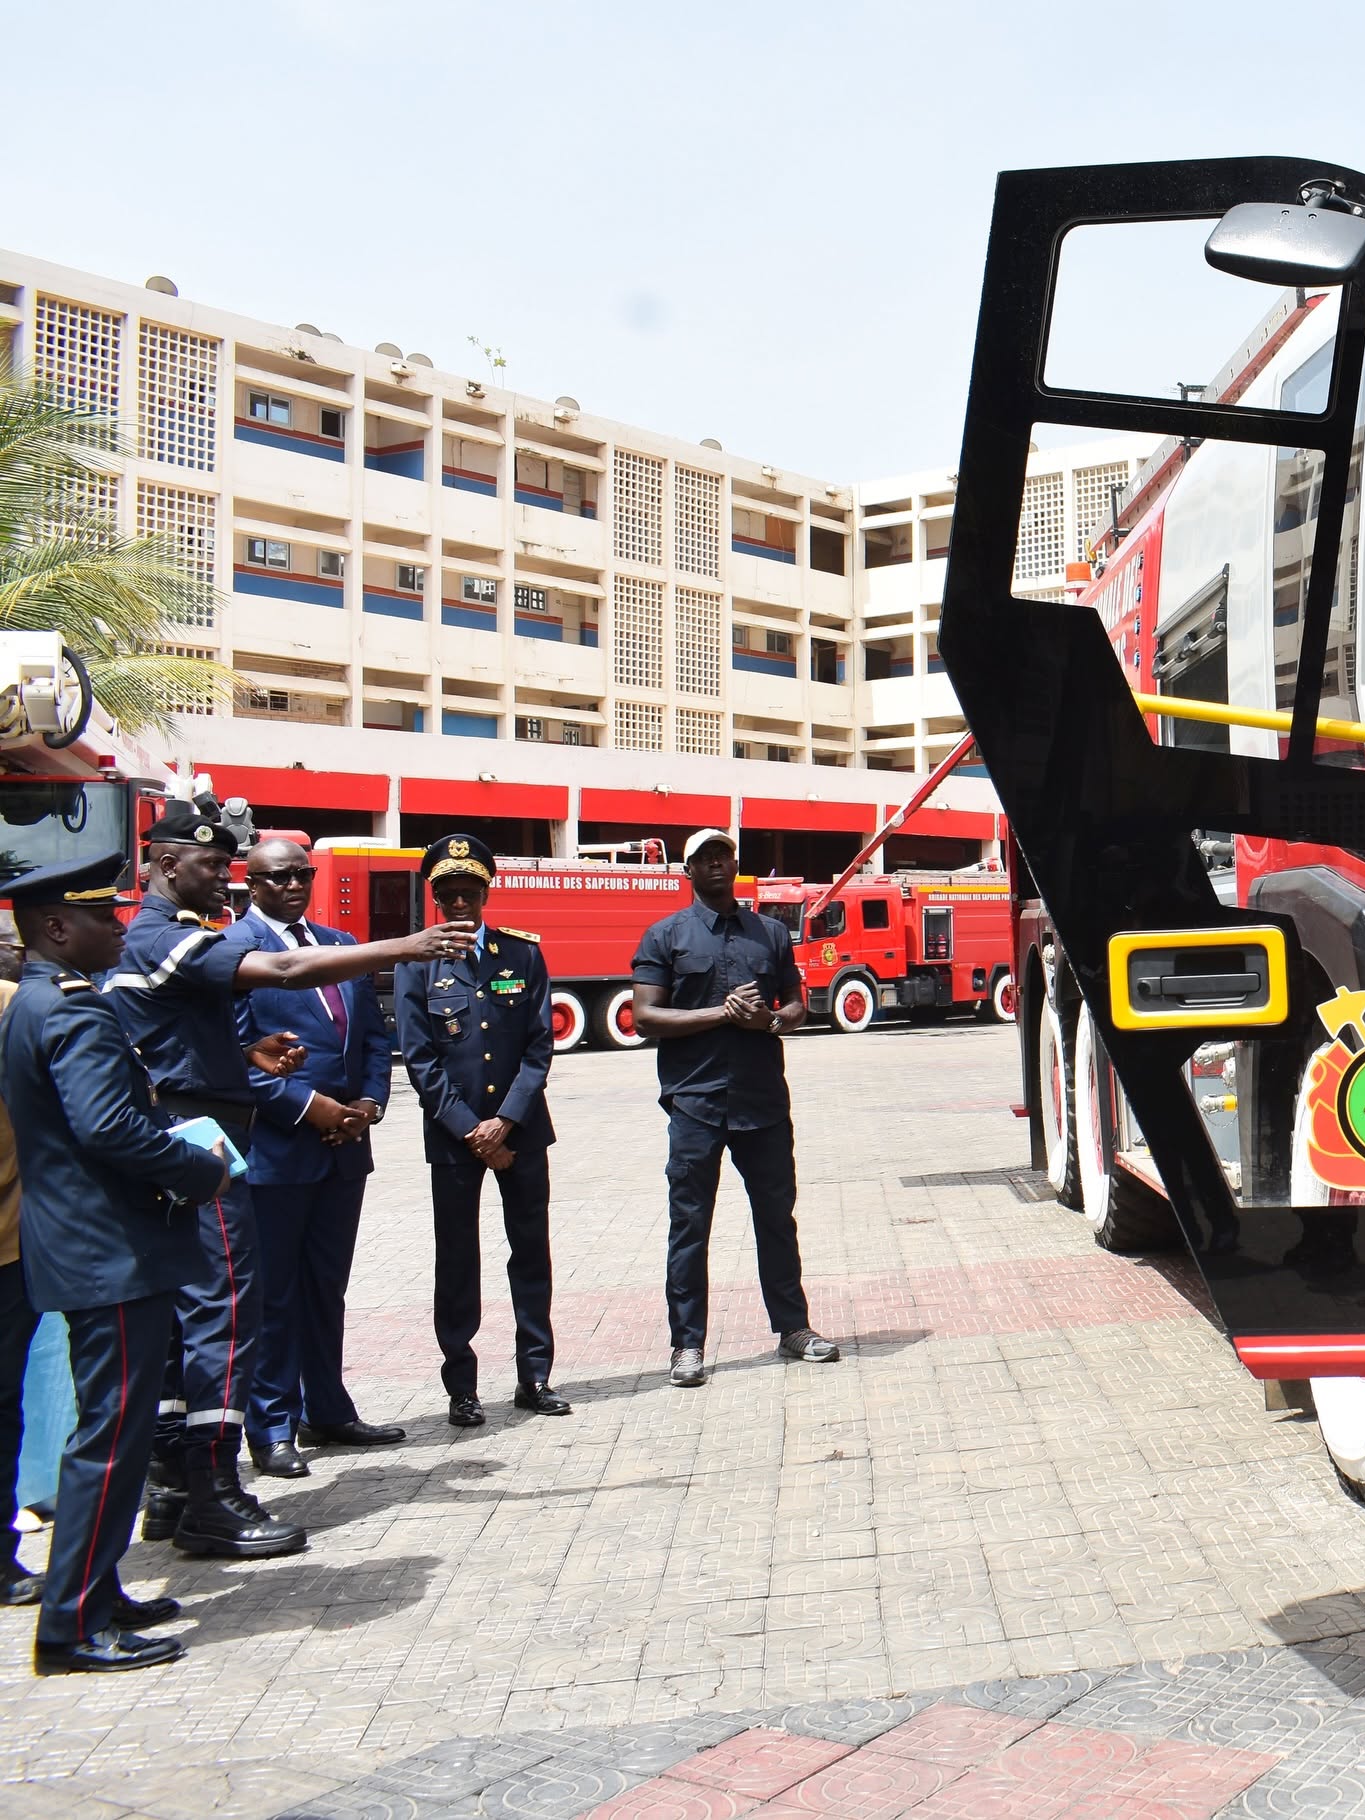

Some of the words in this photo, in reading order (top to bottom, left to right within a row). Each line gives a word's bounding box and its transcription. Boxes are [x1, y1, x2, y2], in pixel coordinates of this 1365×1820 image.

[504, 875, 561, 889] NATIONALE
[563, 876, 583, 890] DES
[585, 877, 629, 890] SAPEURS
[632, 878, 680, 891] POMPIERS
